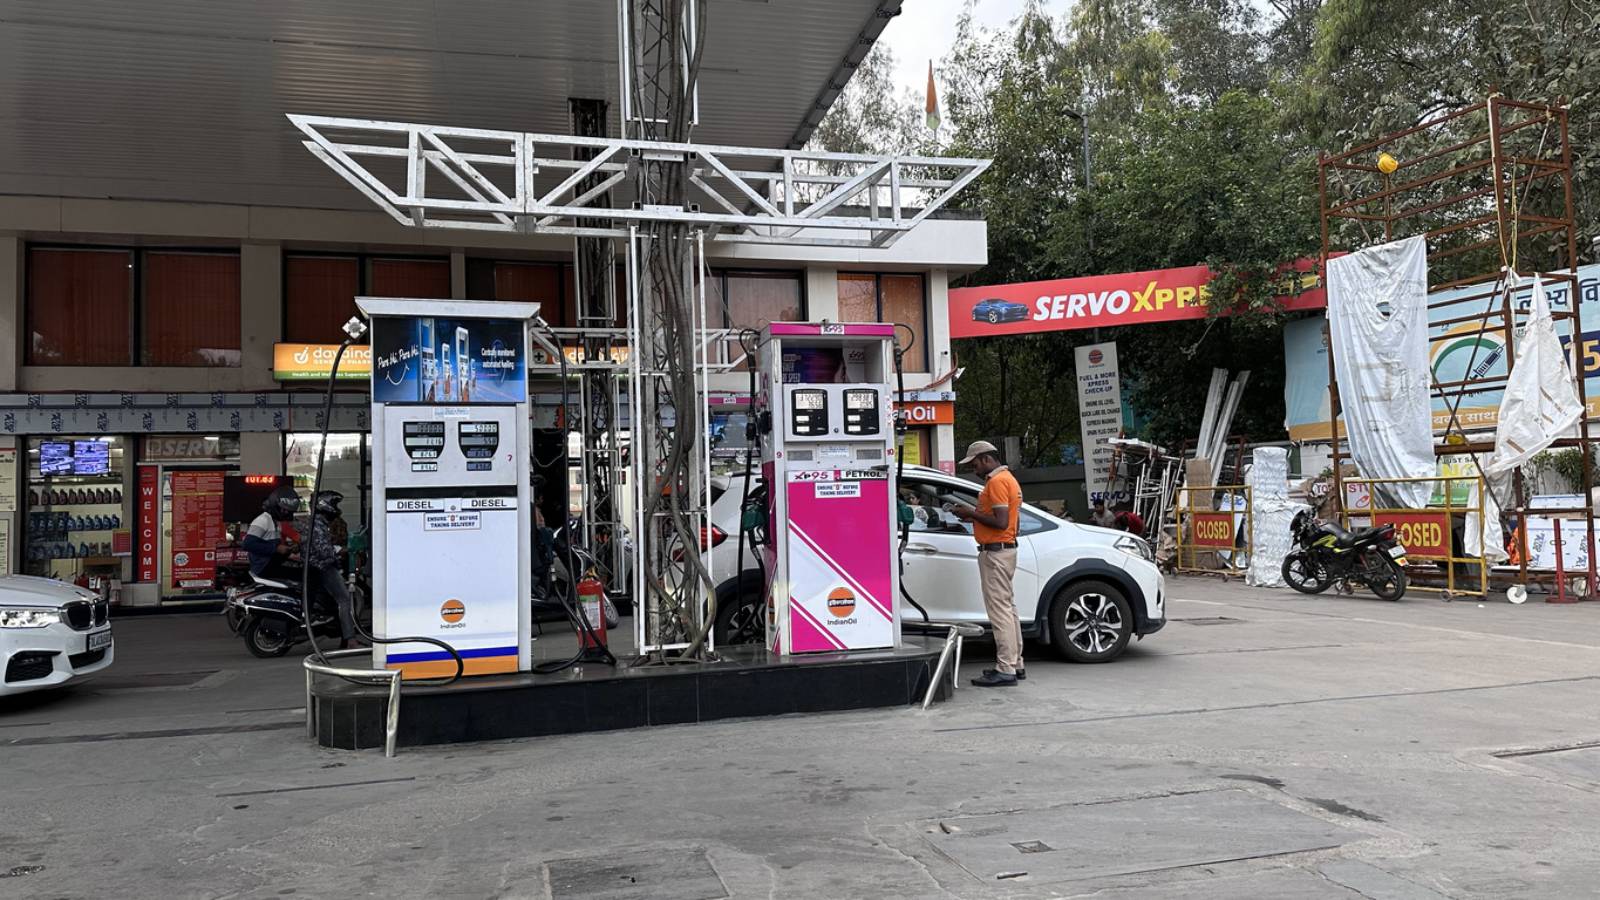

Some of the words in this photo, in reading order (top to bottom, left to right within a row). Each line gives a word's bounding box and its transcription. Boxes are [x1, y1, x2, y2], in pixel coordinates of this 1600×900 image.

[845, 470, 883, 478] PETROL
[396, 501, 434, 509] DIESEL
[471, 499, 508, 507] DIESEL
[1196, 520, 1230, 540] CLOSED
[1400, 522, 1442, 547] OSED
[827, 618, 858, 626] IndianOil
